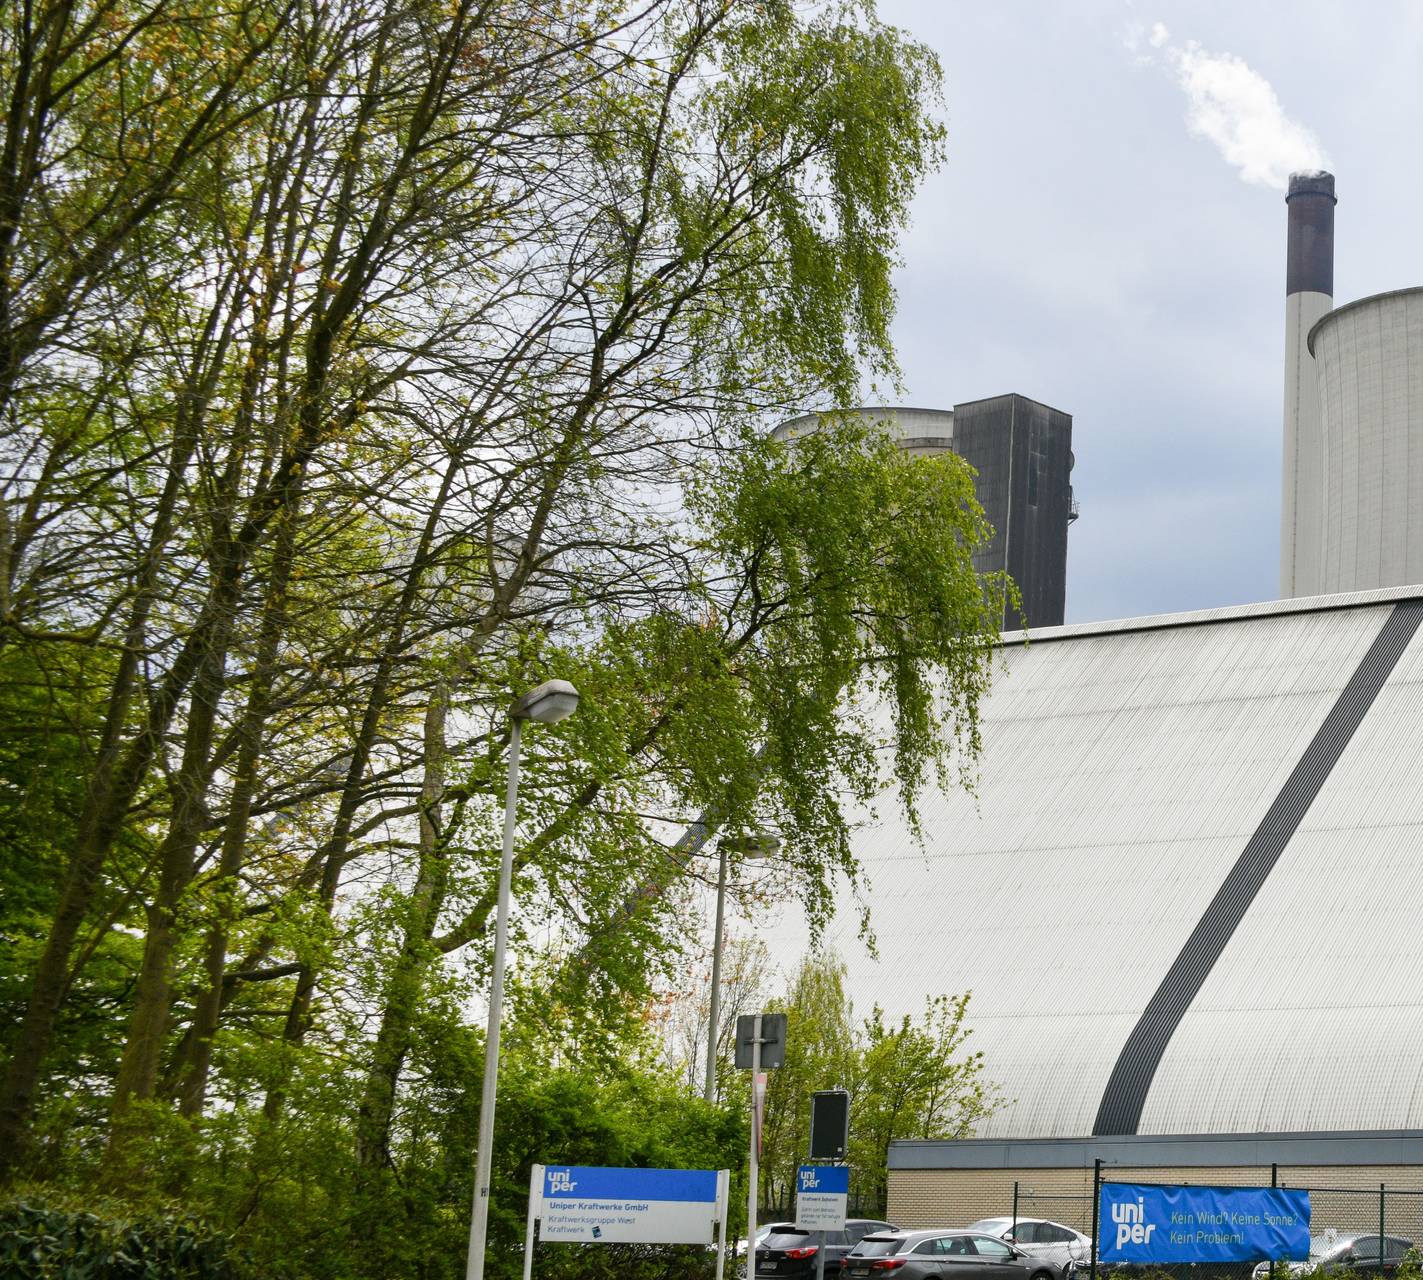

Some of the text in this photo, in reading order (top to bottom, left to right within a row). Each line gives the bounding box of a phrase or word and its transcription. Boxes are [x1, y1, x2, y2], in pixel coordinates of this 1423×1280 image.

[547, 1169, 571, 1182] uni
[800, 1168, 815, 1179] uni
[551, 1181, 578, 1194] per
[802, 1179, 820, 1190] per
[550, 1202, 649, 1212] Uniper Kraftwerke GmbH
[1111, 1196, 1144, 1223] uni
[548, 1215, 636, 1225] Kraftwerksgruppe West
[1171, 1210, 1298, 1226] Kein Wind? Keine Sonne?
[547, 1225, 585, 1234] Kraftwerk
[1116, 1223, 1156, 1250] per
[1170, 1230, 1244, 1245] Kein Problem!
